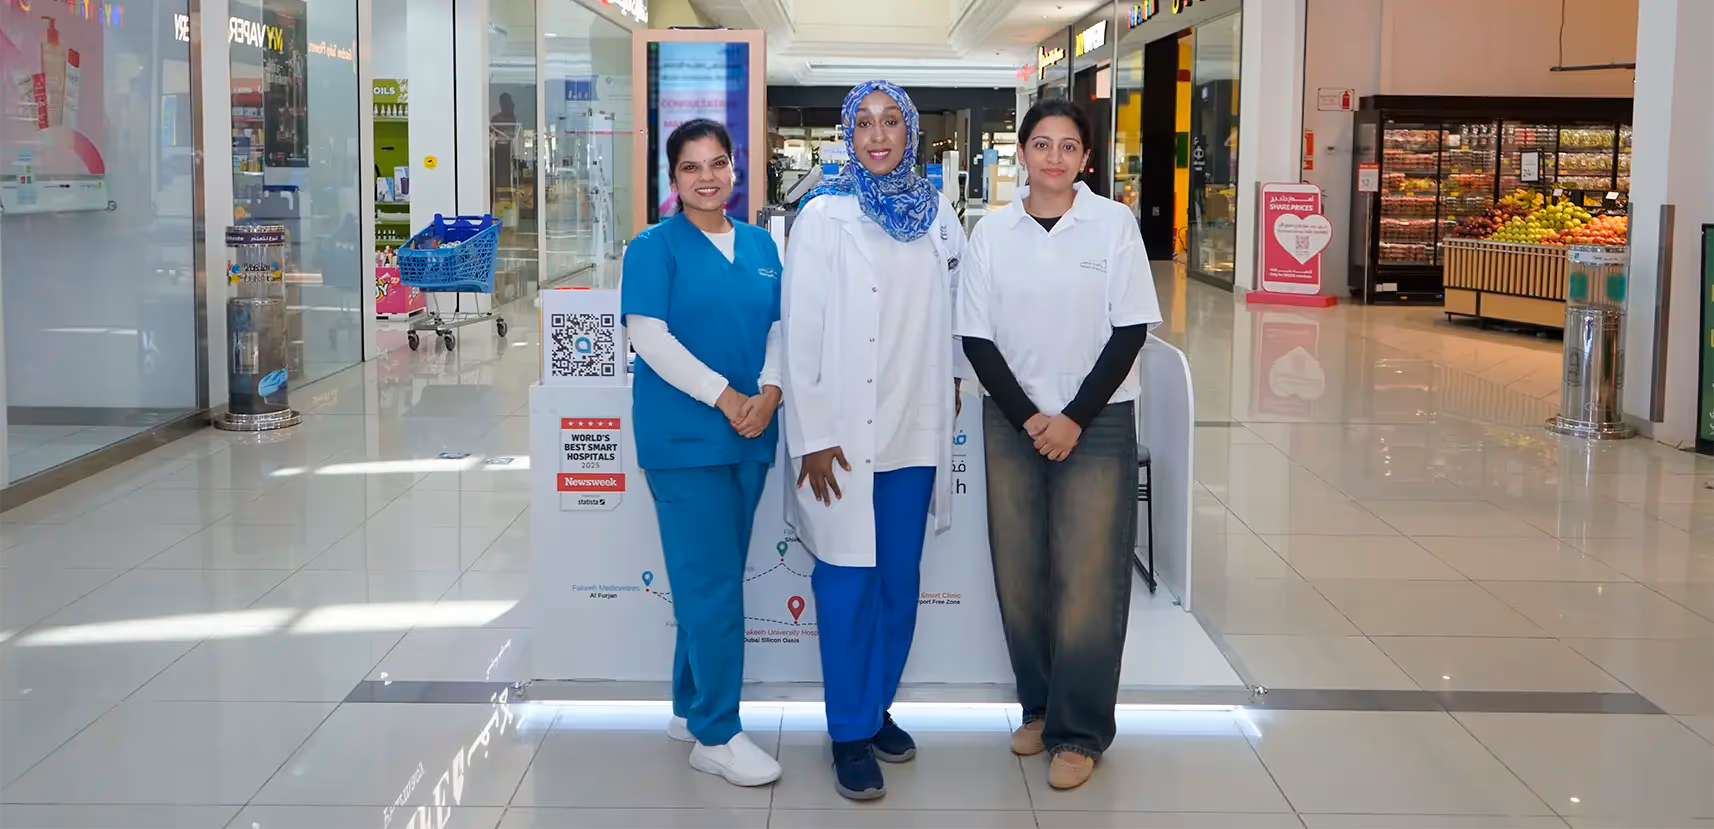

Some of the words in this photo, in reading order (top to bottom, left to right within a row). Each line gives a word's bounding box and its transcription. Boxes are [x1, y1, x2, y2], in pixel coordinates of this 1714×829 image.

[373, 86, 396, 95] OILS
[1290, 204, 1313, 212] PRICES
[571, 434, 610, 442] WORLD'S
[564, 443, 587, 451] BEST
[587, 443, 618, 451] SMART
[567, 453, 615, 461] HOSPITALS
[564, 477, 617, 487] Newsweek
[768, 629, 800, 638] University
